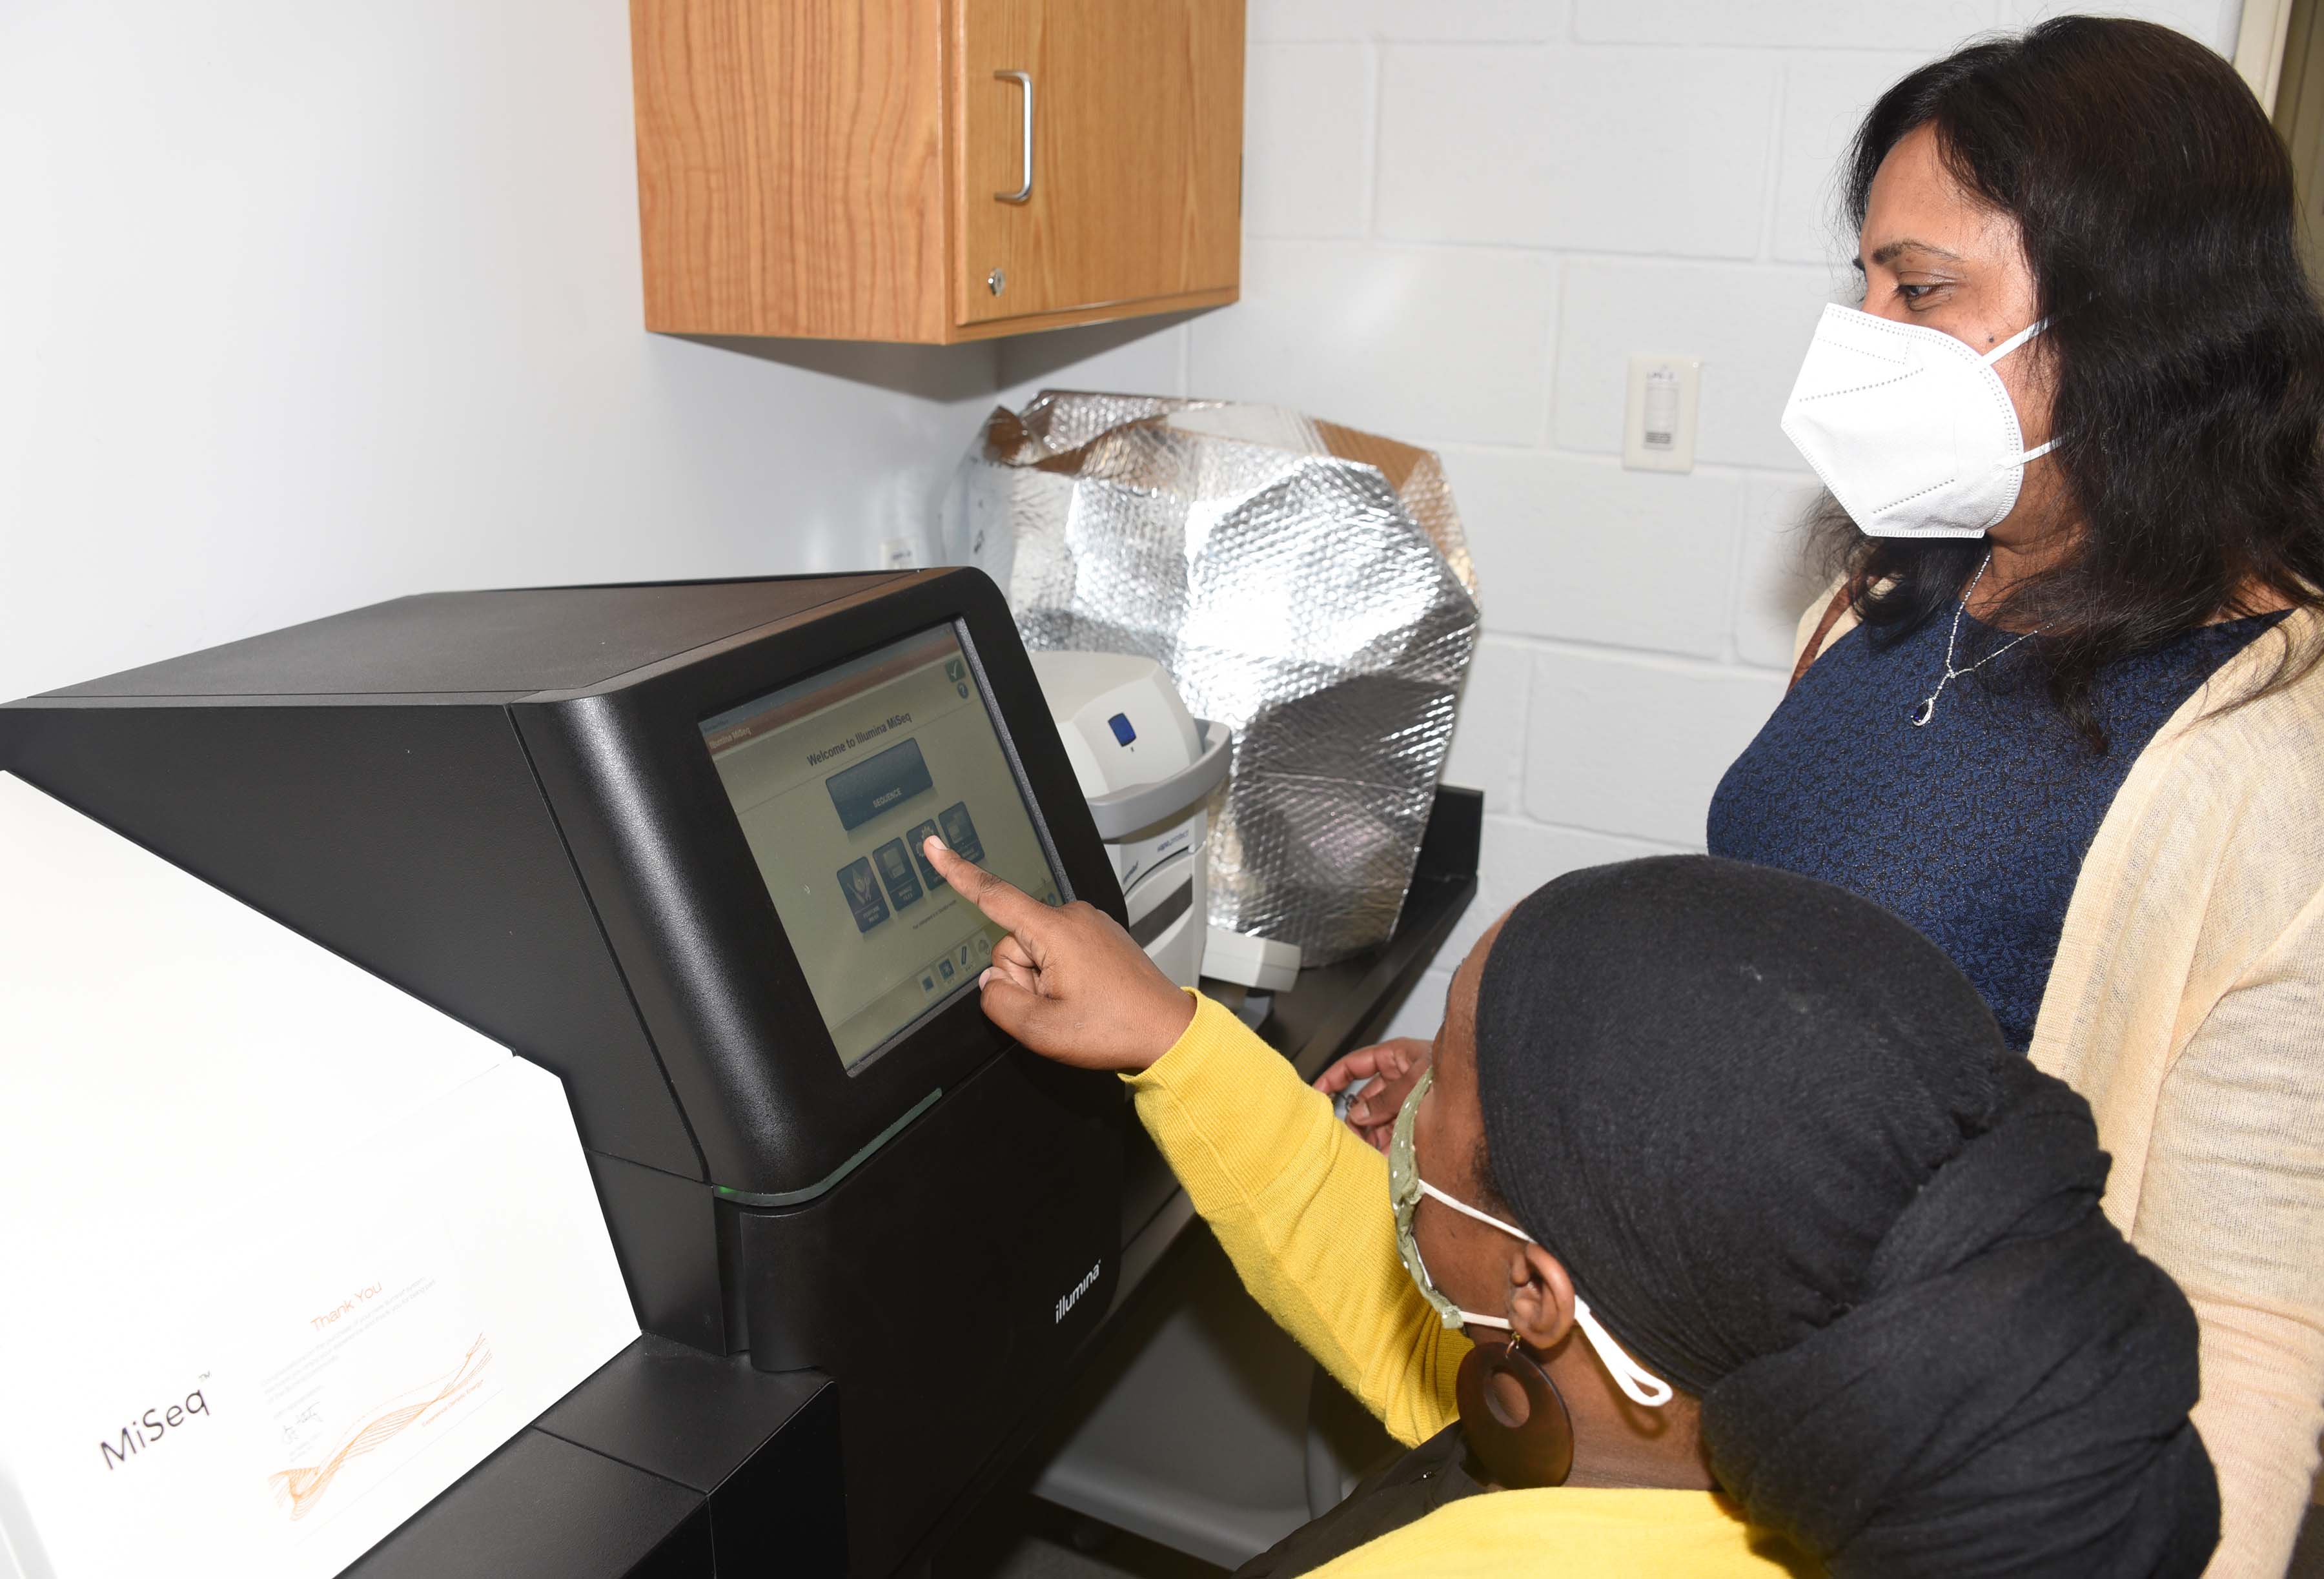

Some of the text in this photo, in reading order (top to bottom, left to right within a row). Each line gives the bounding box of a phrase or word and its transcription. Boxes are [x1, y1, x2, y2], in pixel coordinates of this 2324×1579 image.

[807, 712, 913, 767] Welcome to Illumina MiSeq
[310, 1298, 355, 1332] Thank
[354, 1280, 383, 1303] You
[1055, 1262, 1099, 1325] illumina
[99, 1388, 210, 1471] MiSeq
